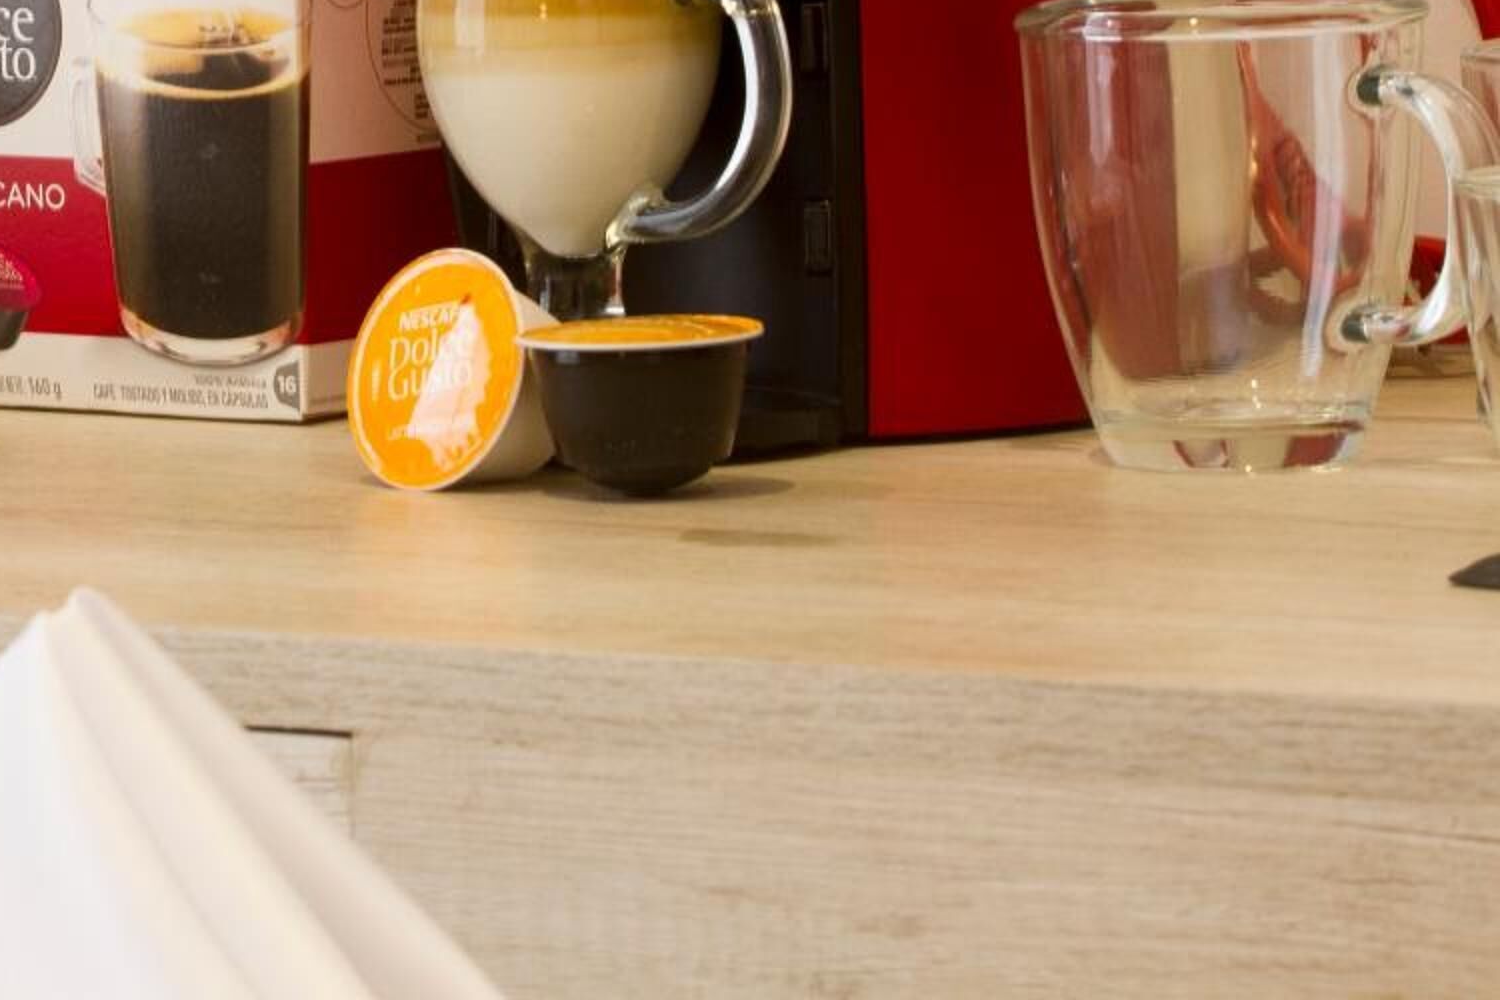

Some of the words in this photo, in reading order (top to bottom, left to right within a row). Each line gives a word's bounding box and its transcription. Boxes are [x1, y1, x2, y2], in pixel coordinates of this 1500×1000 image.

[398, 302, 468, 332] NESCAF
[389, 328, 470, 371] Dol
[277, 375, 297, 394] 16
